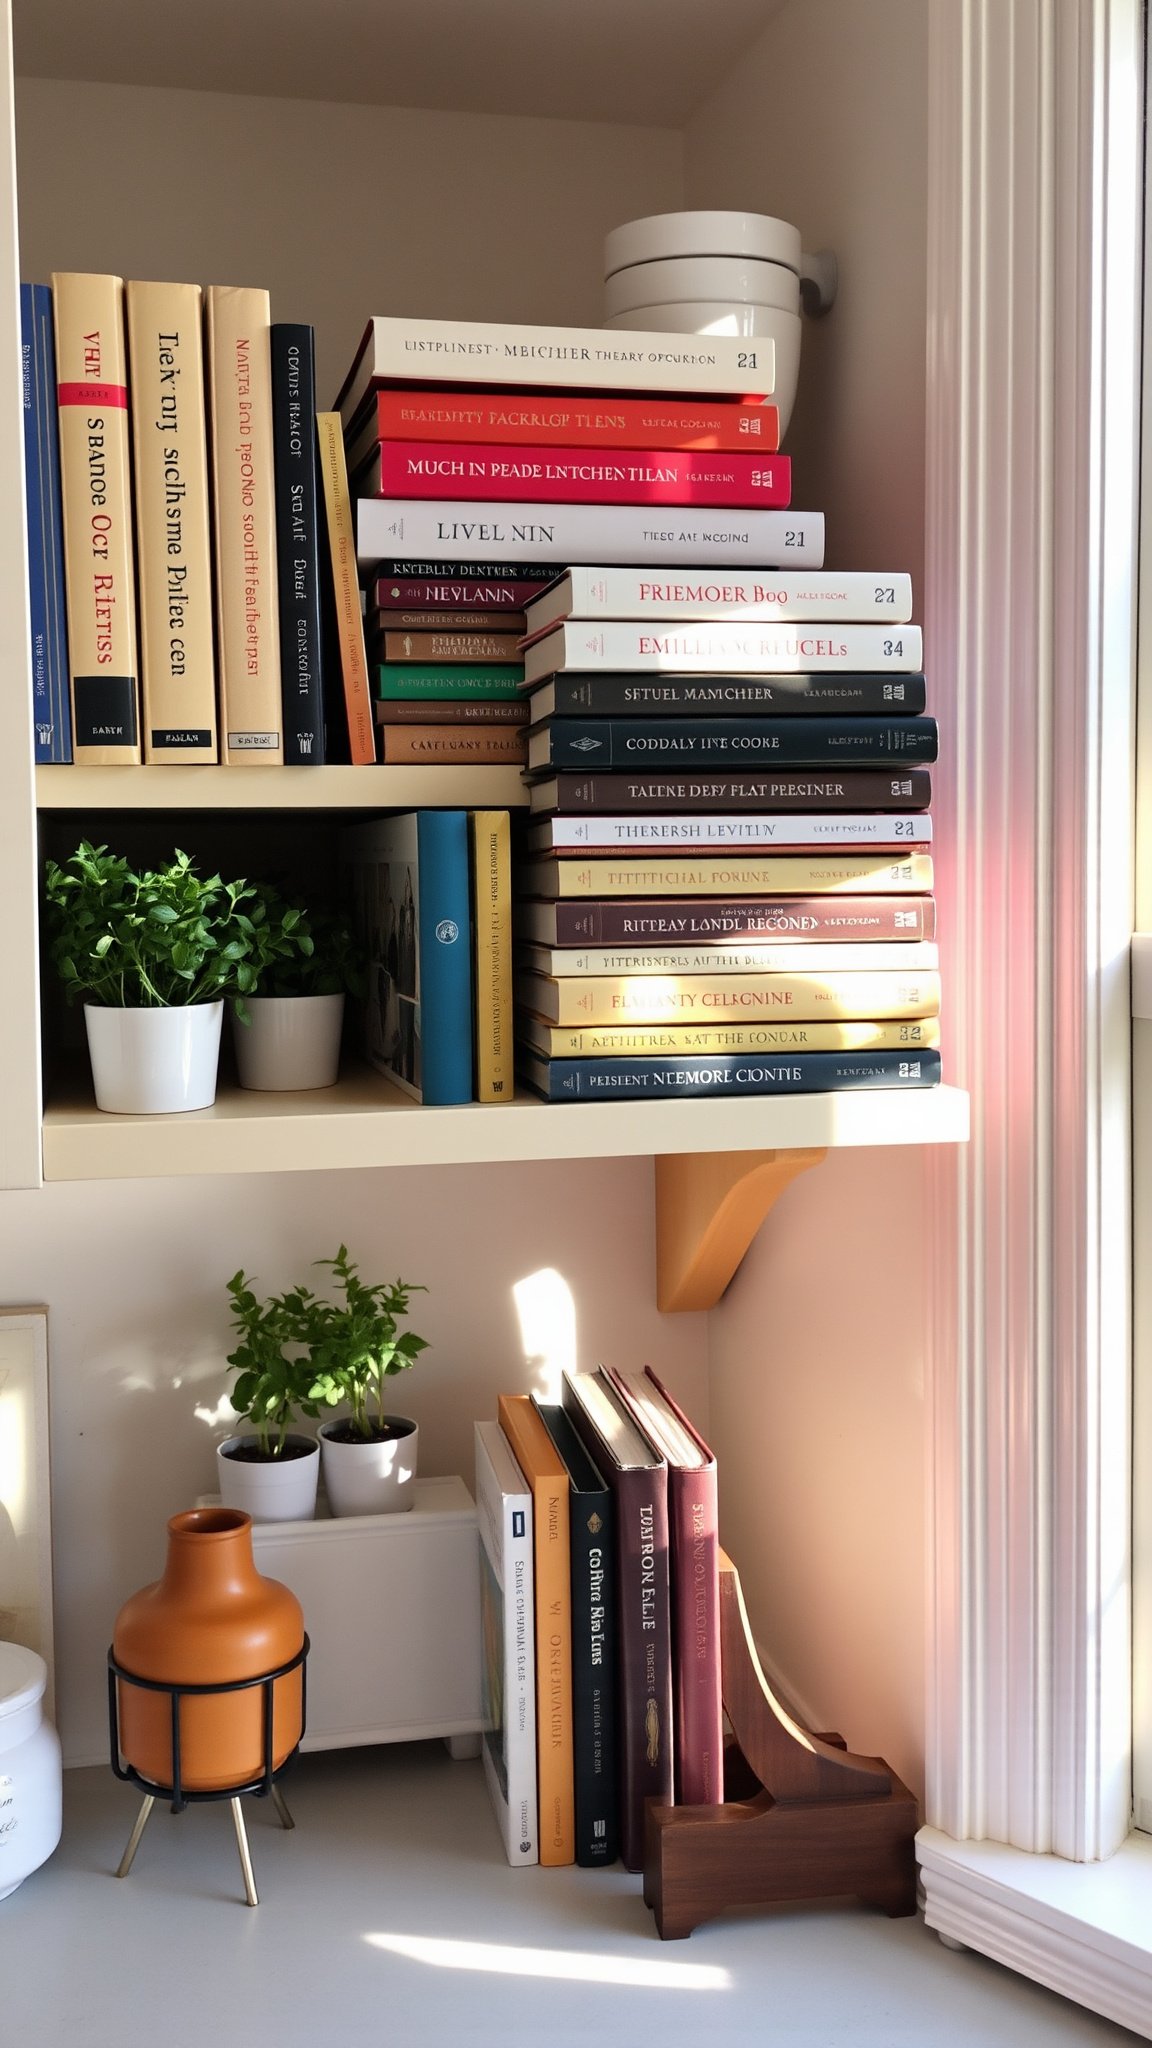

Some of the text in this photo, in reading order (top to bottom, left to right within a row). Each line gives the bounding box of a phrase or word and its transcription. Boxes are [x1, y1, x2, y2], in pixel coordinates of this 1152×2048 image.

[407, 460, 465, 476] MUCH
[468, 462, 486, 477] IN
[626, 737, 698, 750] CODDALY
[731, 737, 780, 749] COOKE
[717, 1032, 744, 1045] THE
